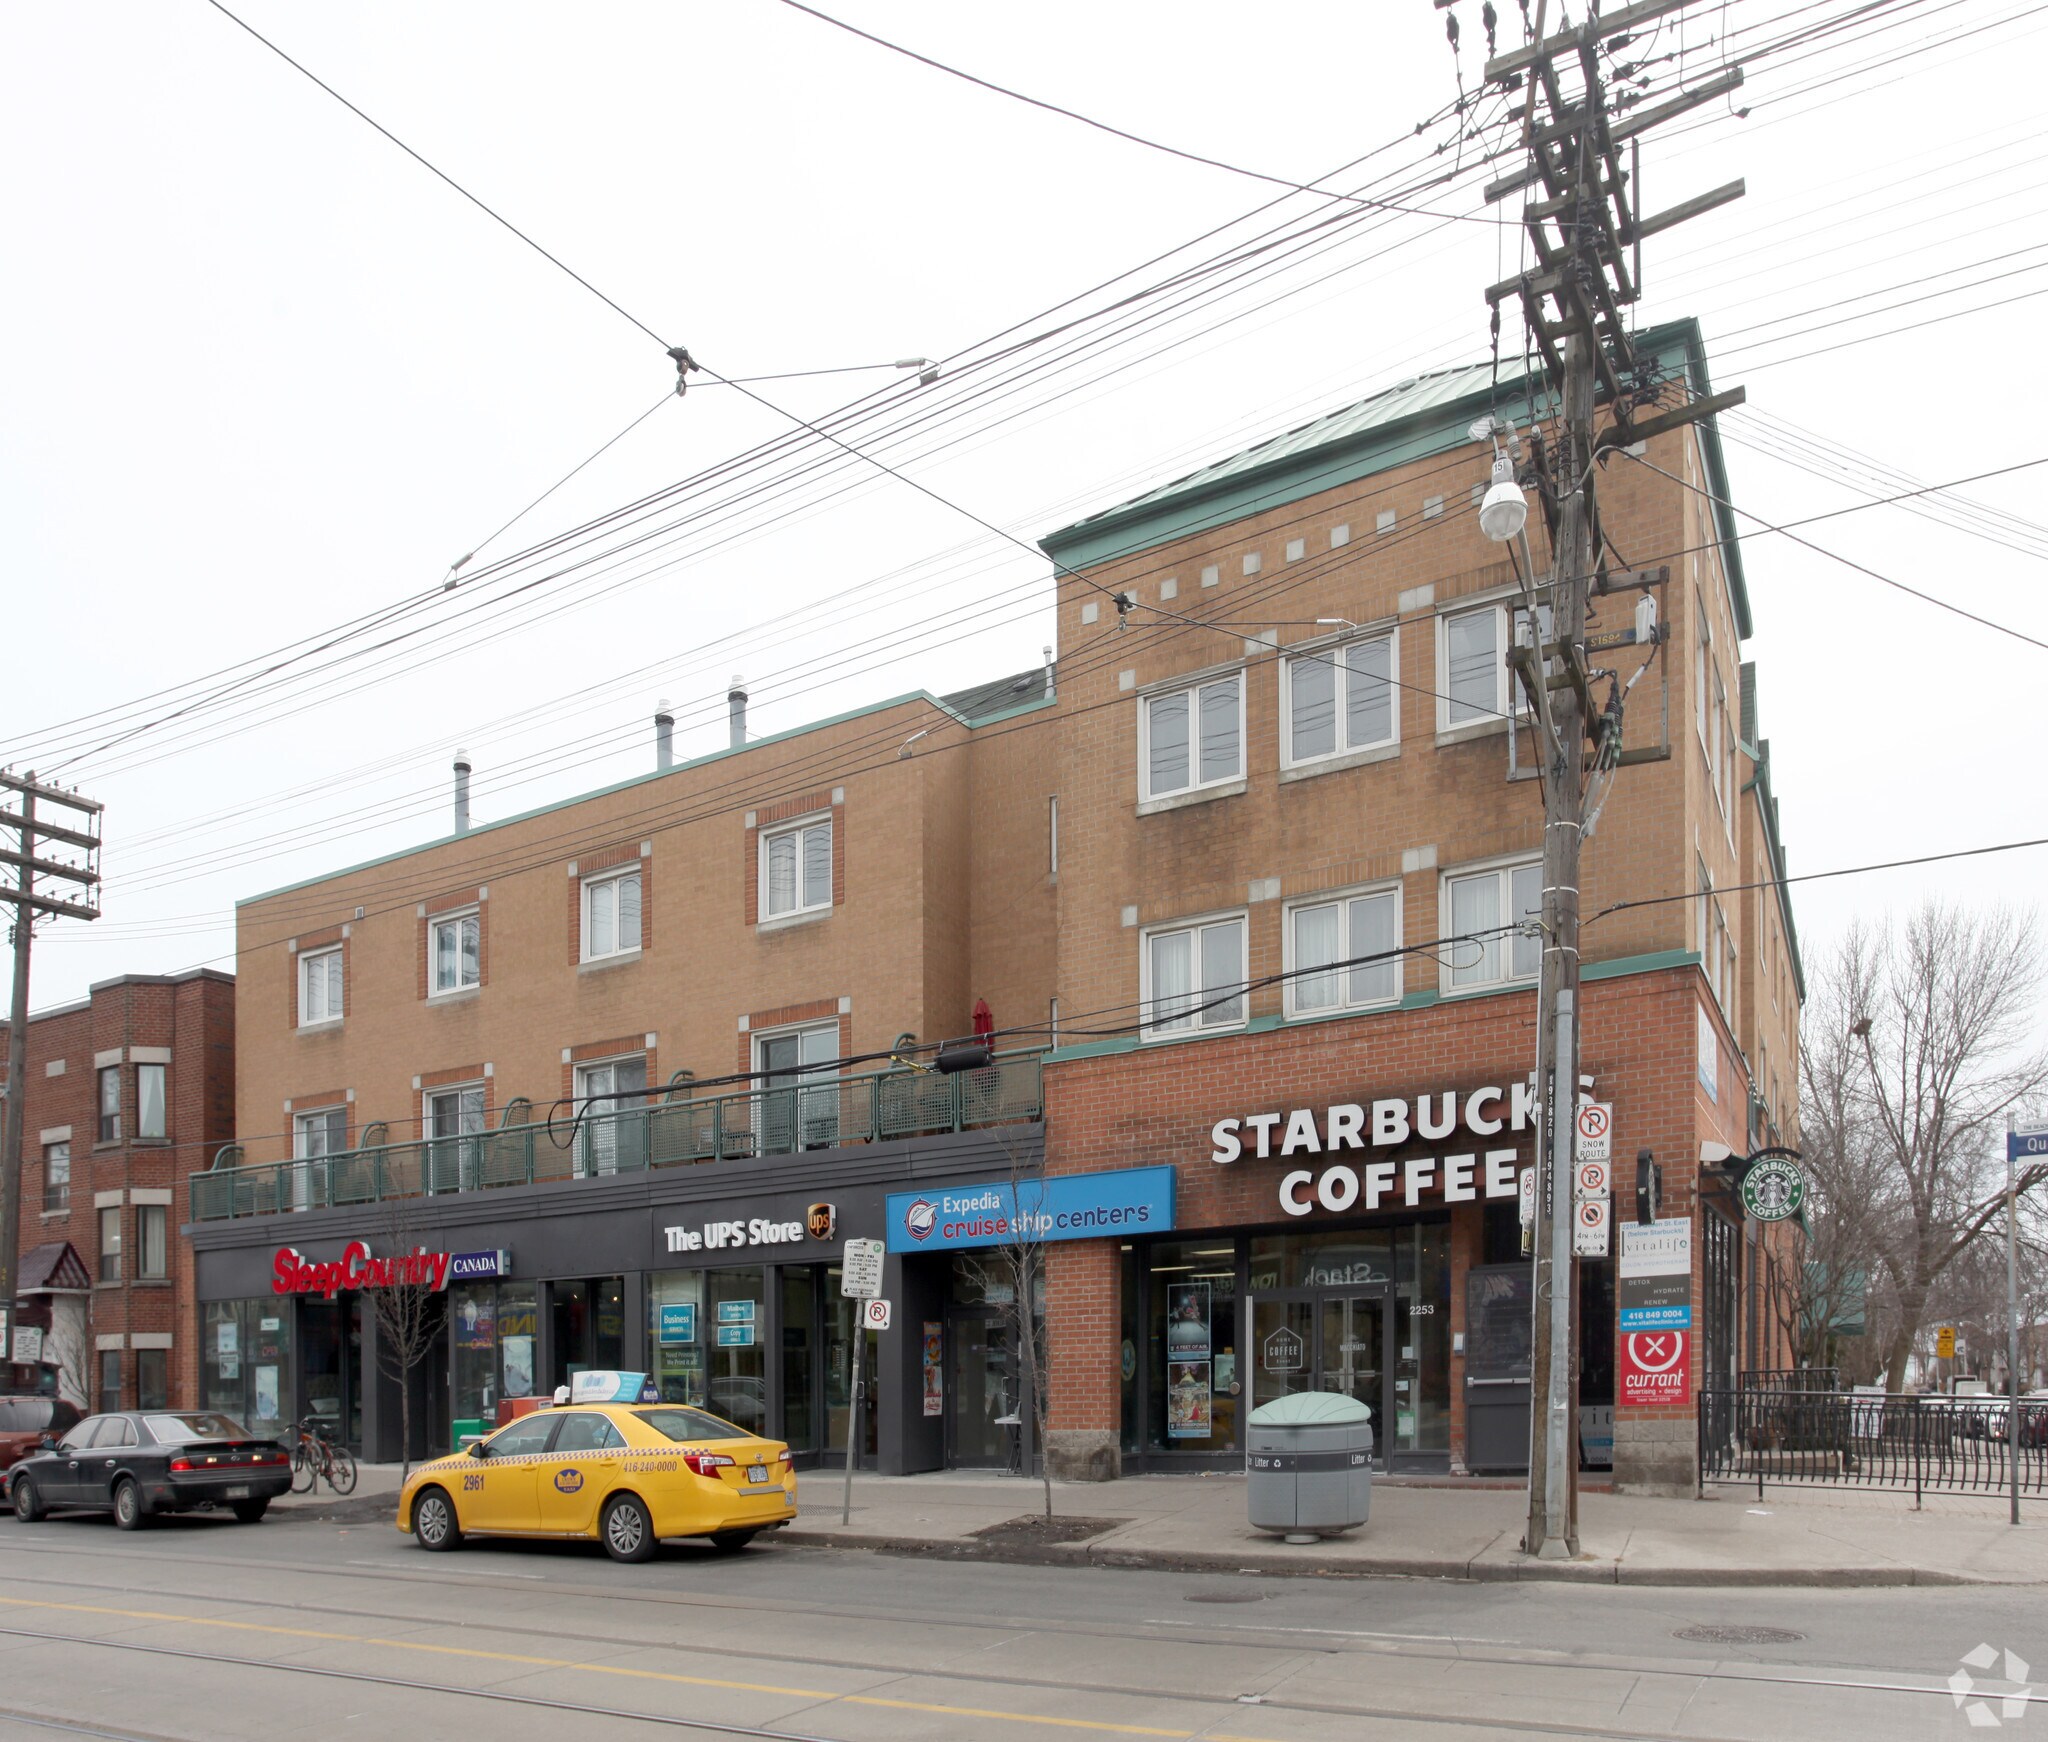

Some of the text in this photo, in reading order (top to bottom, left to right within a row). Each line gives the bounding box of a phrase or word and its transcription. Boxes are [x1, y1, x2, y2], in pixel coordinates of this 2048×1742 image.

[1582, 1140, 1604, 1148] SNOW
[2028, 1138, 2046, 1152] Qu
[1278, 1148, 1518, 1216] COFFEE
[1746, 1162, 1800, 1188] STARBUCKS
[943, 1192, 1000, 1216] Expedia
[1751, 1202, 1792, 1218] COFFEE
[810, 1214, 829, 1234] ups
[943, 1204, 1149, 1239] cruise ship centers
[664, 1218, 804, 1252] The UPS Store
[1650, 1228, 1684, 1236] Starbucks)
[454, 1256, 496, 1274] CANADA
[1410, 1305, 1434, 1315] 2253
[664, 1315, 689, 1324] Business
[1270, 1346, 1298, 1356] COFFEE
[1626, 1369, 1684, 1387] currant
[1255, 1457, 1269, 1467] Litter
[1352, 1454, 1365, 1464] Litter
[464, 1474, 484, 1491] 2961
